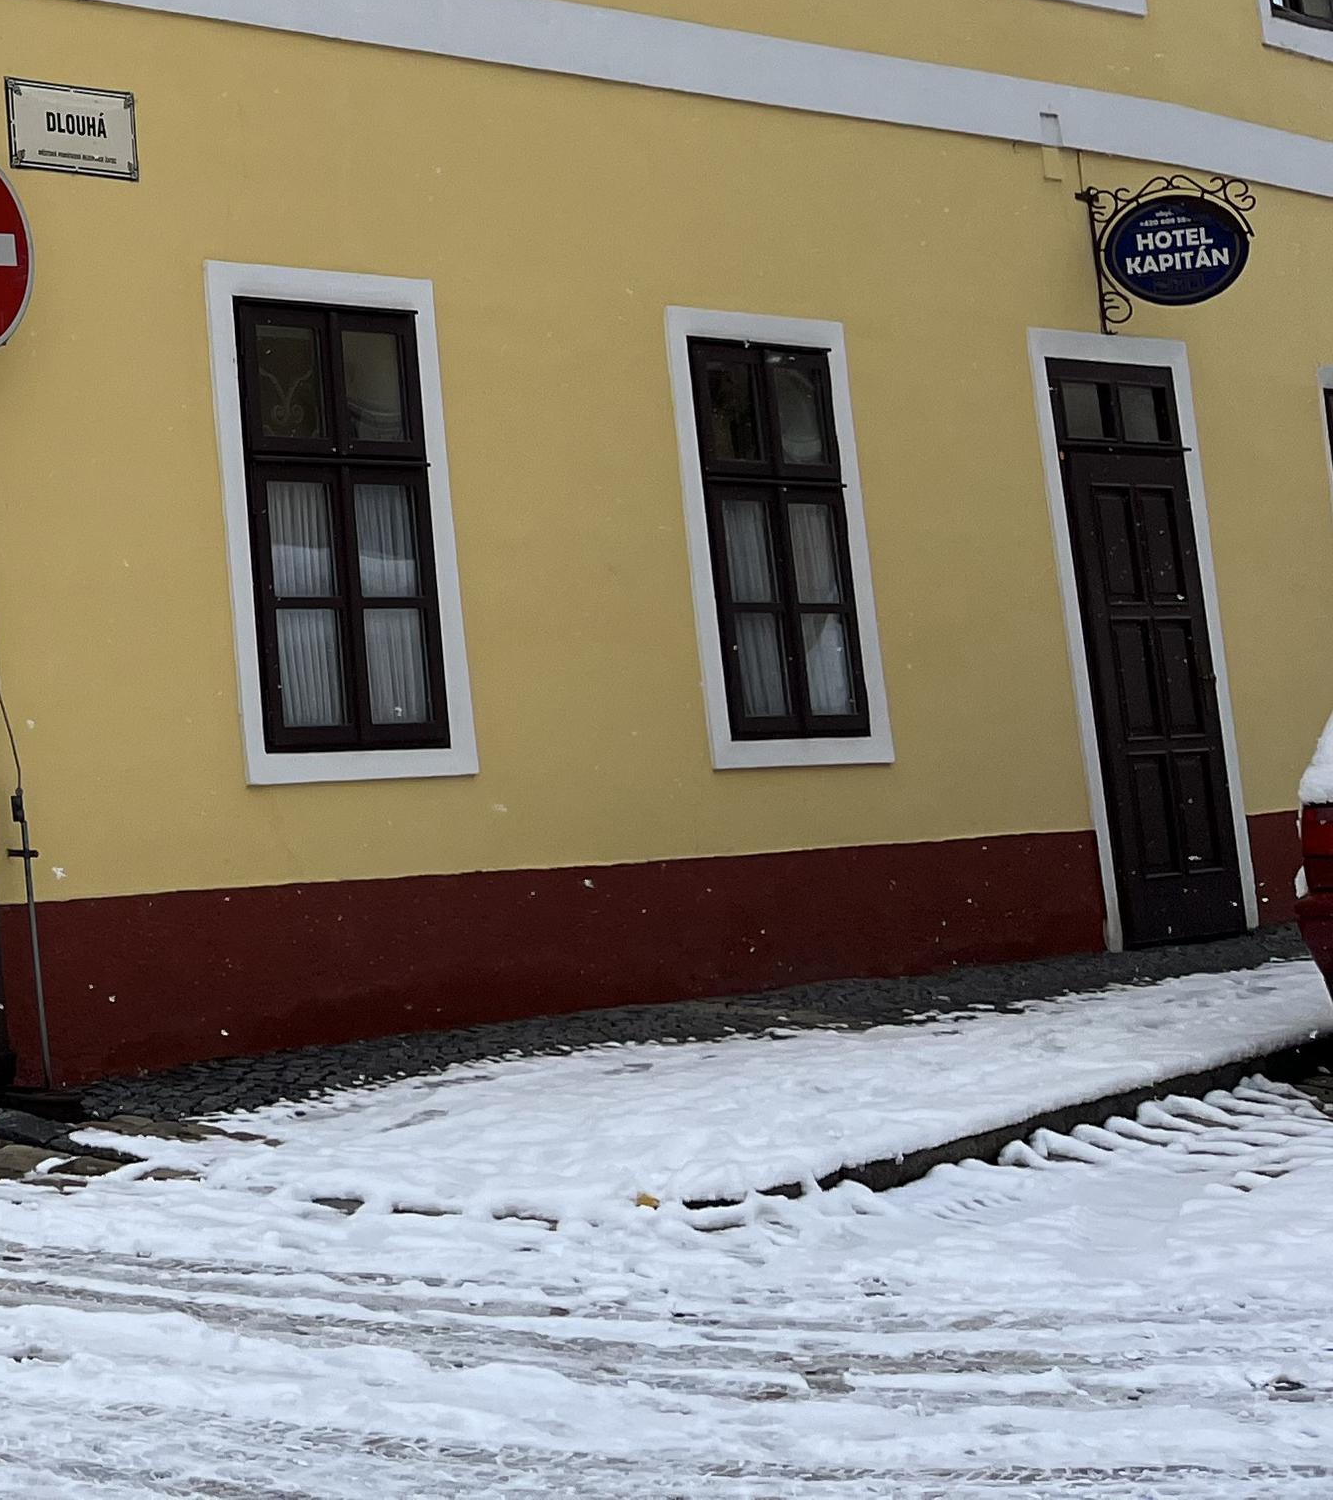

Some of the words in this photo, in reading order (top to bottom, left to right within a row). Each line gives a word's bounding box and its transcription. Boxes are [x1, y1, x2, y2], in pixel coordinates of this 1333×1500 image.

[45, 111, 108, 139] DLOUHÁ
[1136, 227, 1214, 251] HOTEL
[1125, 246, 1230, 275] KAPITÁN
